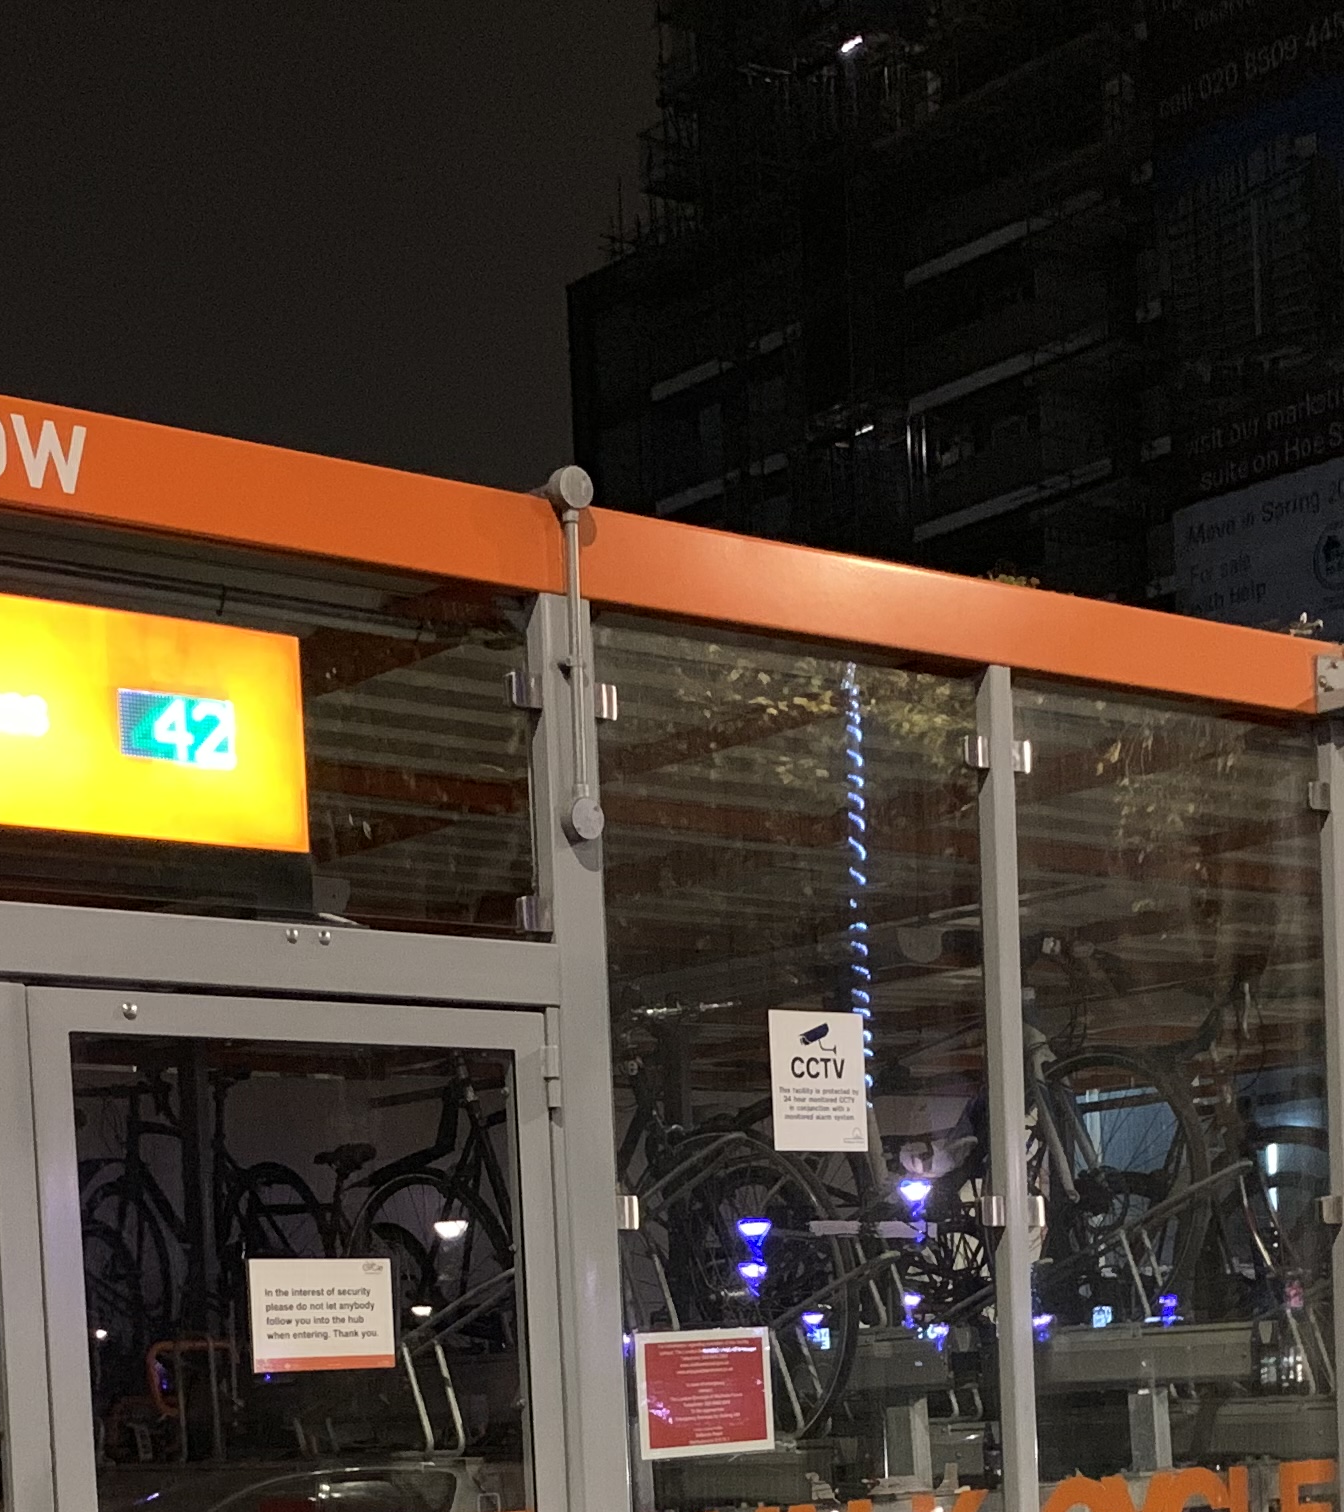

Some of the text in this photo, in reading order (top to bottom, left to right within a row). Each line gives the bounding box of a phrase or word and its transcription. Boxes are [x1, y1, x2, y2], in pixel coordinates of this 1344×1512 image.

[1252, 451, 1279, 473] on
[1285, 434, 1325, 463] Hoe
[1262, 490, 1320, 524] Spring
[154, 696, 235, 770] 42
[791, 1056, 845, 1079] CCTV
[265, 1287, 371, 1297] In the interest of security
[265, 1301, 375, 1312] please do not let anybody
[266, 1315, 364, 1327] follow you into the hub
[267, 1329, 379, 1341] when entering. Thank you.
